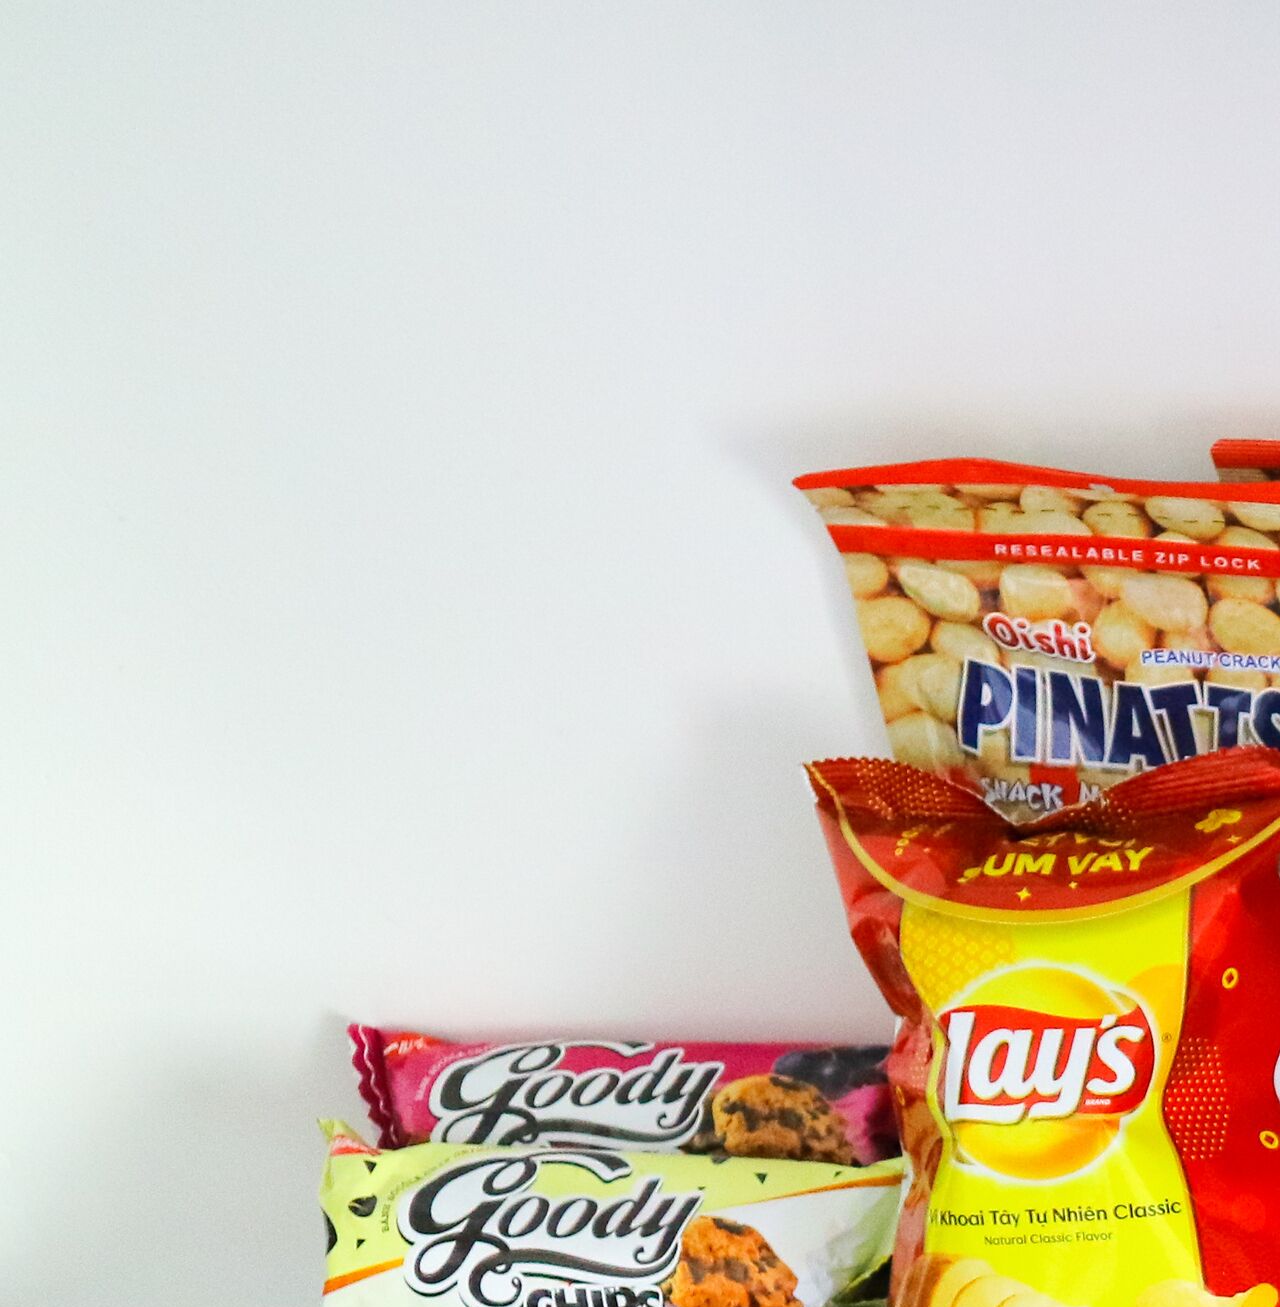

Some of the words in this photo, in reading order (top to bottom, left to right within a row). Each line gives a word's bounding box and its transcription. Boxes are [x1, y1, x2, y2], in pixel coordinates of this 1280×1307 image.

[993, 542, 1144, 563] RESEALABLE
[1155, 551, 1190, 566] ZIP
[1200, 555, 1262, 571] LOCK
[983, 612, 1097, 663] Oishi
[1142, 649, 1215, 668] PEANUT
[943, 1011, 1145, 1124] Lay's
[434, 1039, 722, 1149] Goody
[405, 1149, 703, 1305] Goody
[939, 1209, 984, 1227] Khoai
[988, 1209, 1021, 1229] Tây
[1025, 1208, 1048, 1228] Tự
[1051, 1205, 1108, 1224] Nhiên
[1113, 1199, 1182, 1221] Classic
[983, 1233, 1027, 1247] Natural
[1029, 1231, 1073, 1245] Classic
[1075, 1230, 1113, 1243] Flavor
